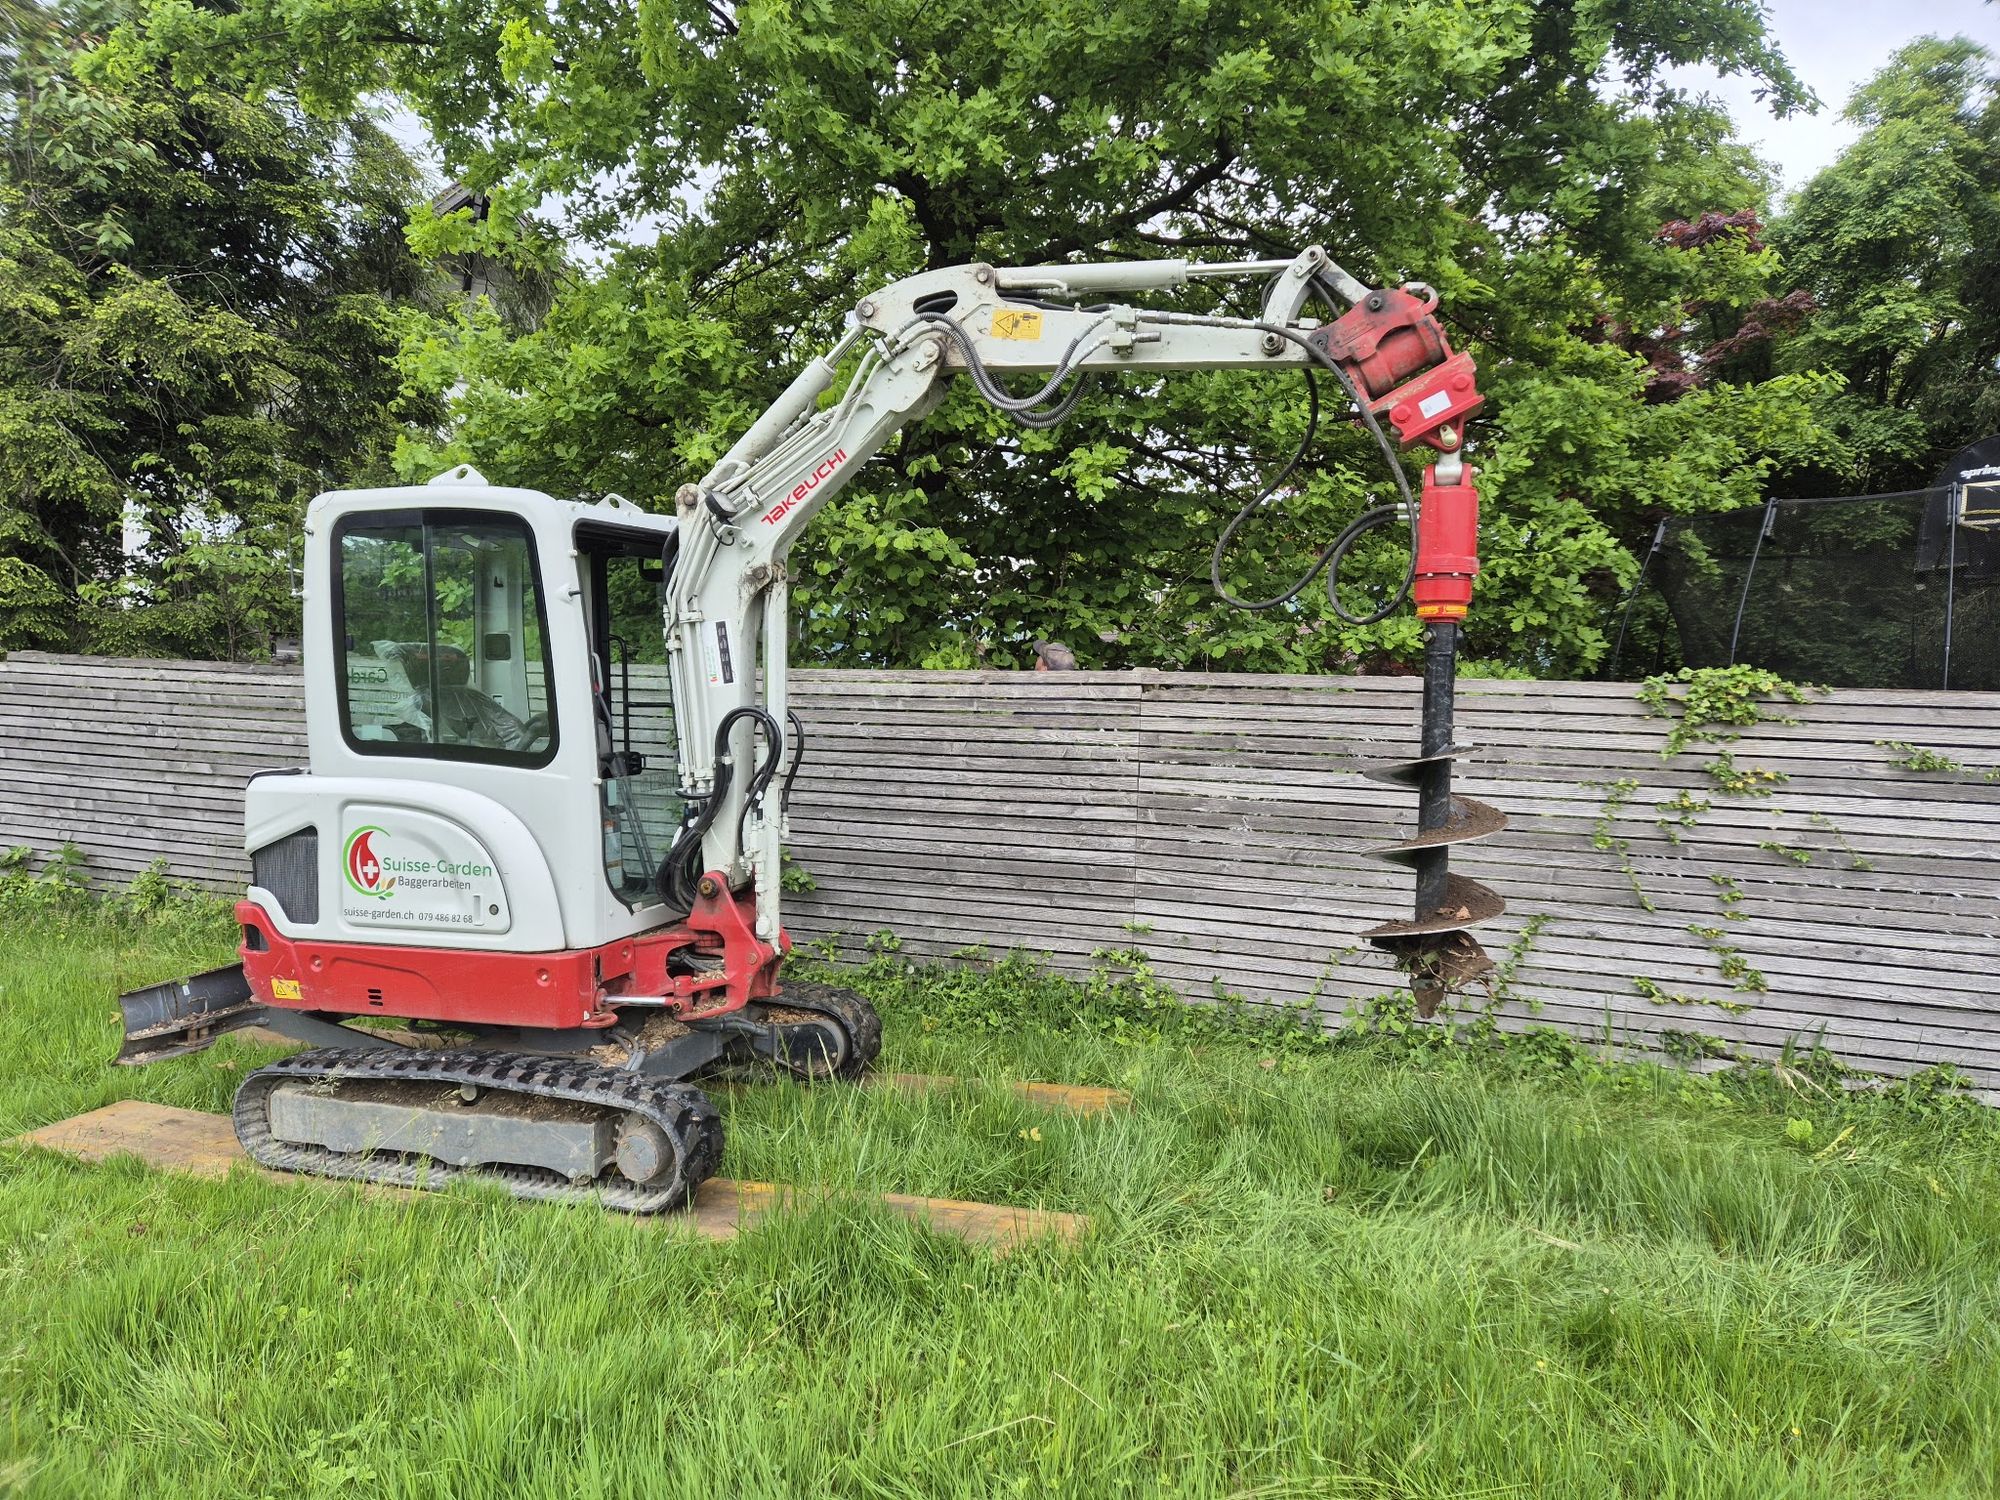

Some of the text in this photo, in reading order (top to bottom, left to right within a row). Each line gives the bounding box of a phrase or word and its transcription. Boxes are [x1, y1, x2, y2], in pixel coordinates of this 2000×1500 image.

[760, 448, 848, 526] TAKEUCHI
[382, 857, 492, 877] Suisse-Garden
[398, 875, 471, 890] Baggerarbeiten
[343, 907, 473, 923] suisse-garden.ch 079 486 82 68
